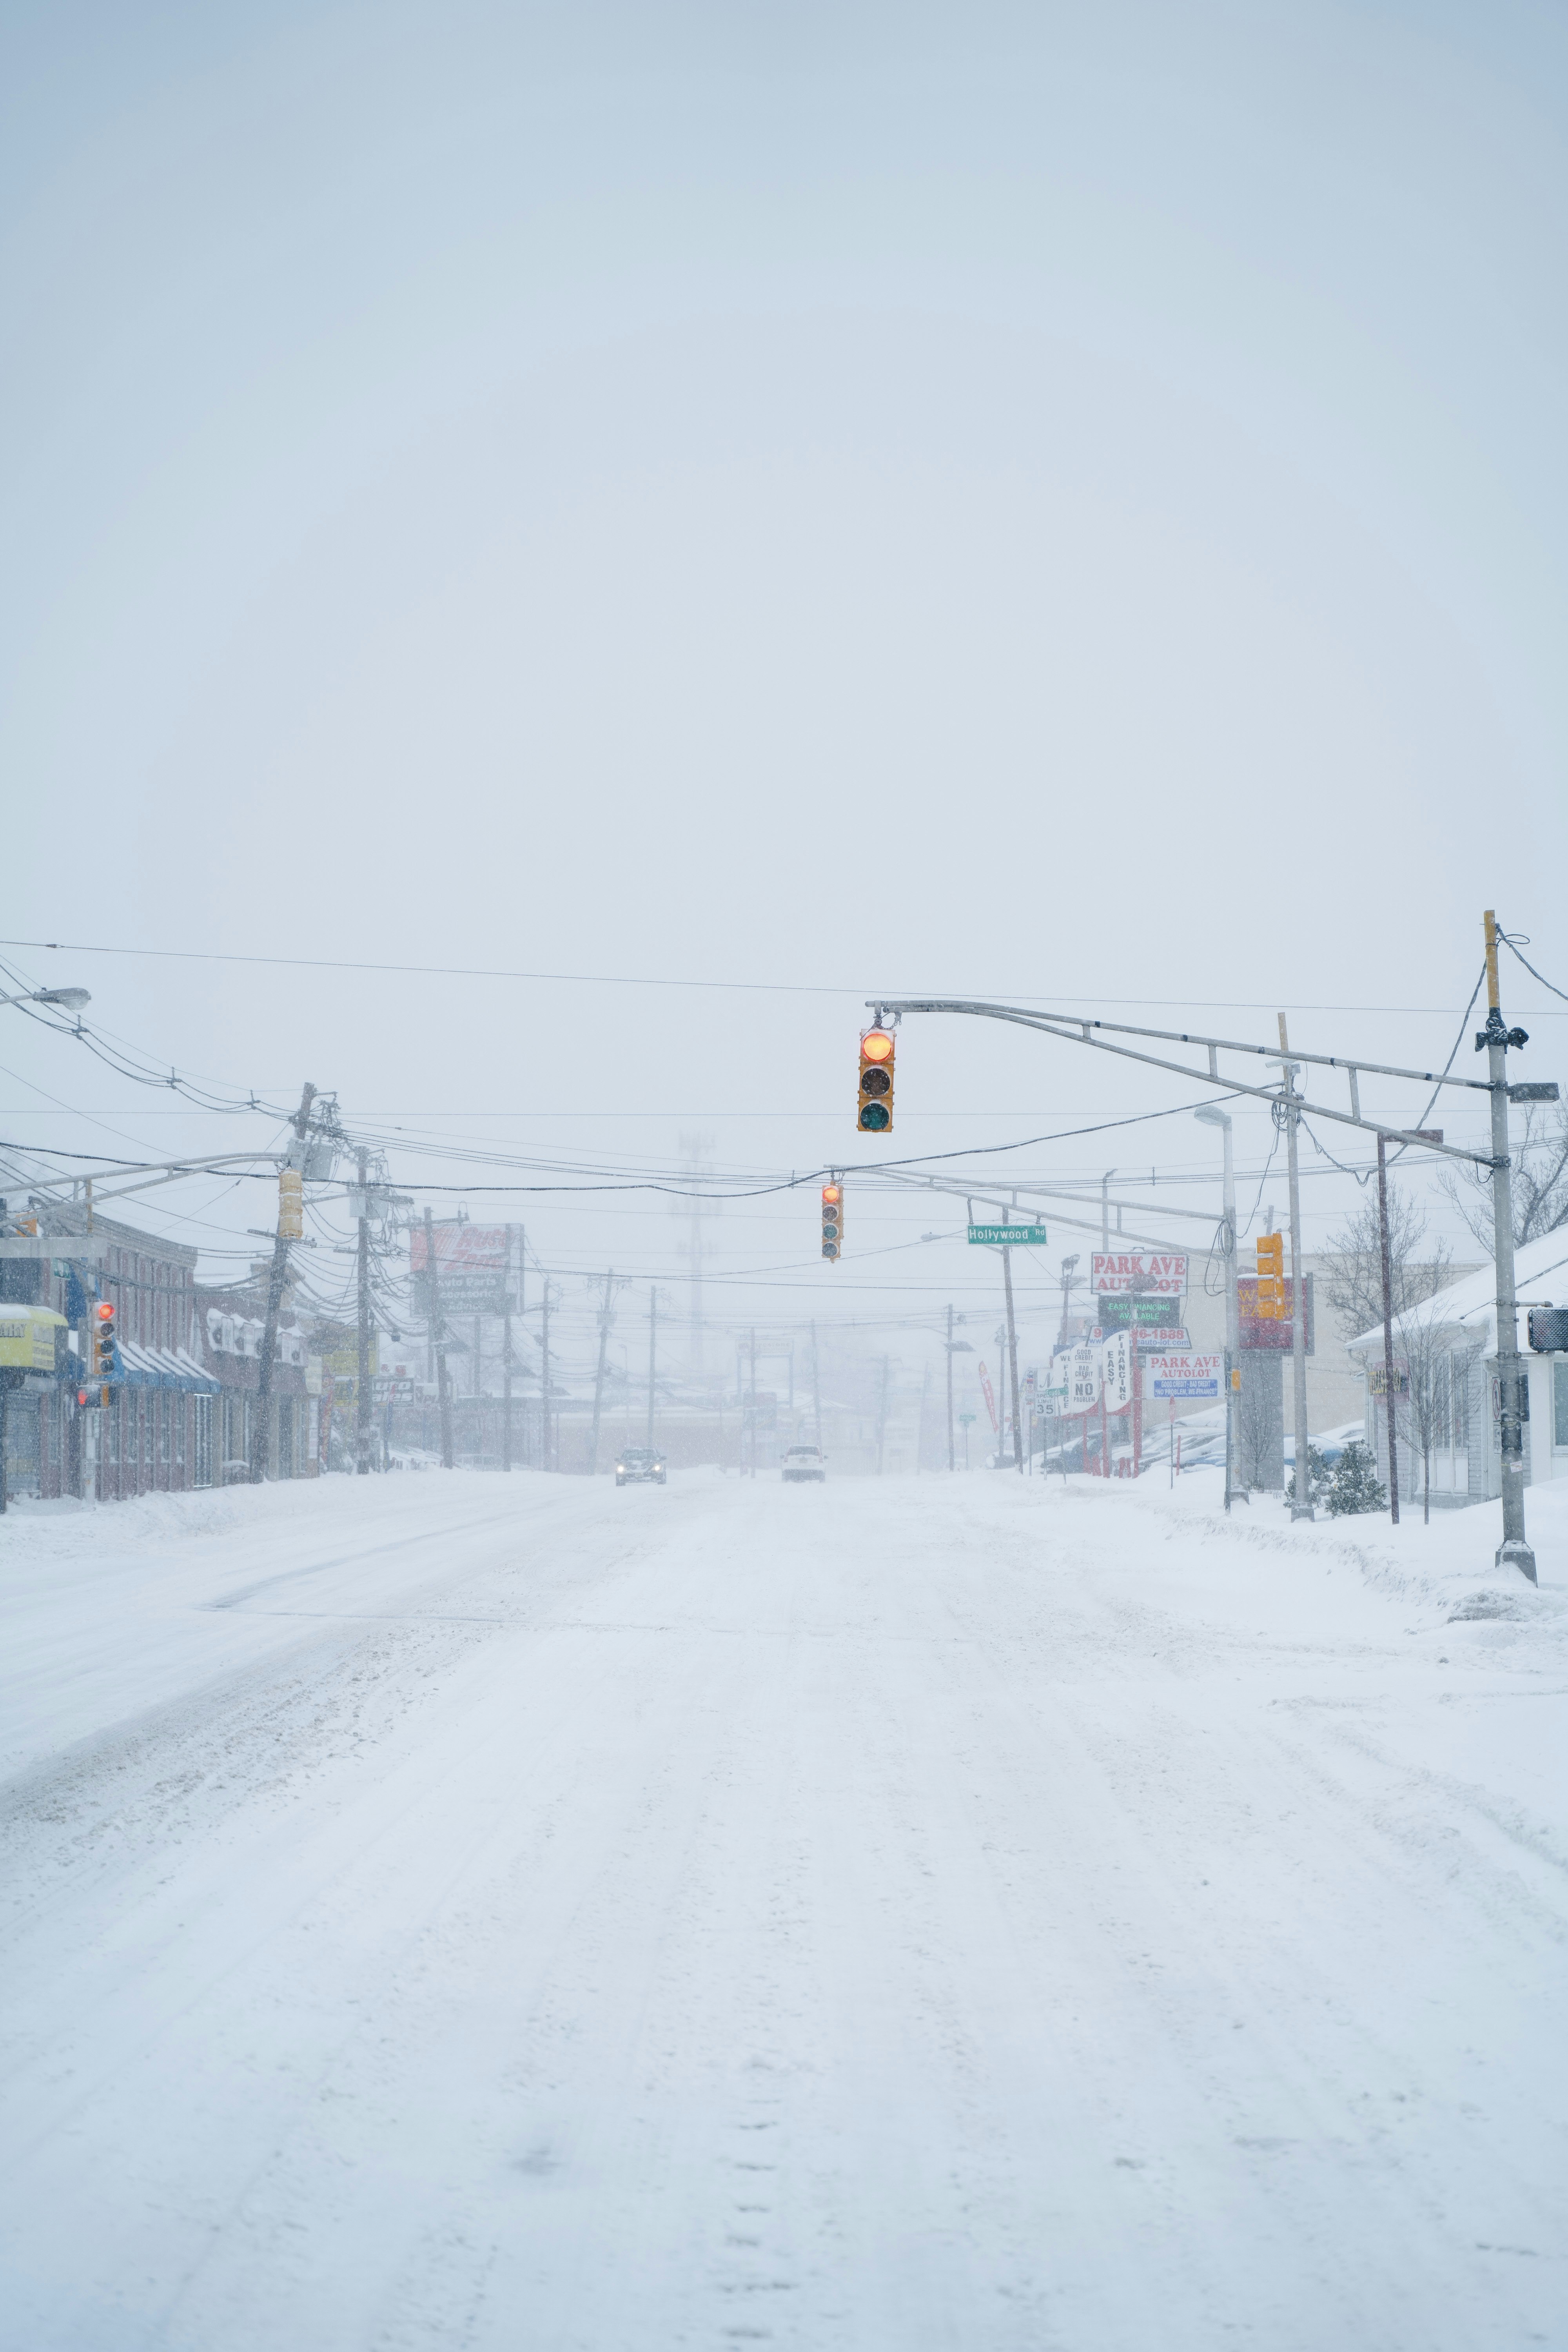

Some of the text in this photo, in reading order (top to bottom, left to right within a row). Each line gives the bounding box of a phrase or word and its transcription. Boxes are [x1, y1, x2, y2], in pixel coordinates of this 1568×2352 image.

[969, 1229, 1028, 1241] Hollywood
[1094, 1256, 1185, 1275] PARK AVE
[1118, 1334, 1126, 1401] FINANCING
[1151, 1356, 1220, 1368] PARK AVE
[1160, 1368, 1211, 1377] AUTOLOT
[371, 1381, 411, 1390] uto
[1075, 1383, 1093, 1396] NO
[1037, 1405, 1054, 1414] 35
